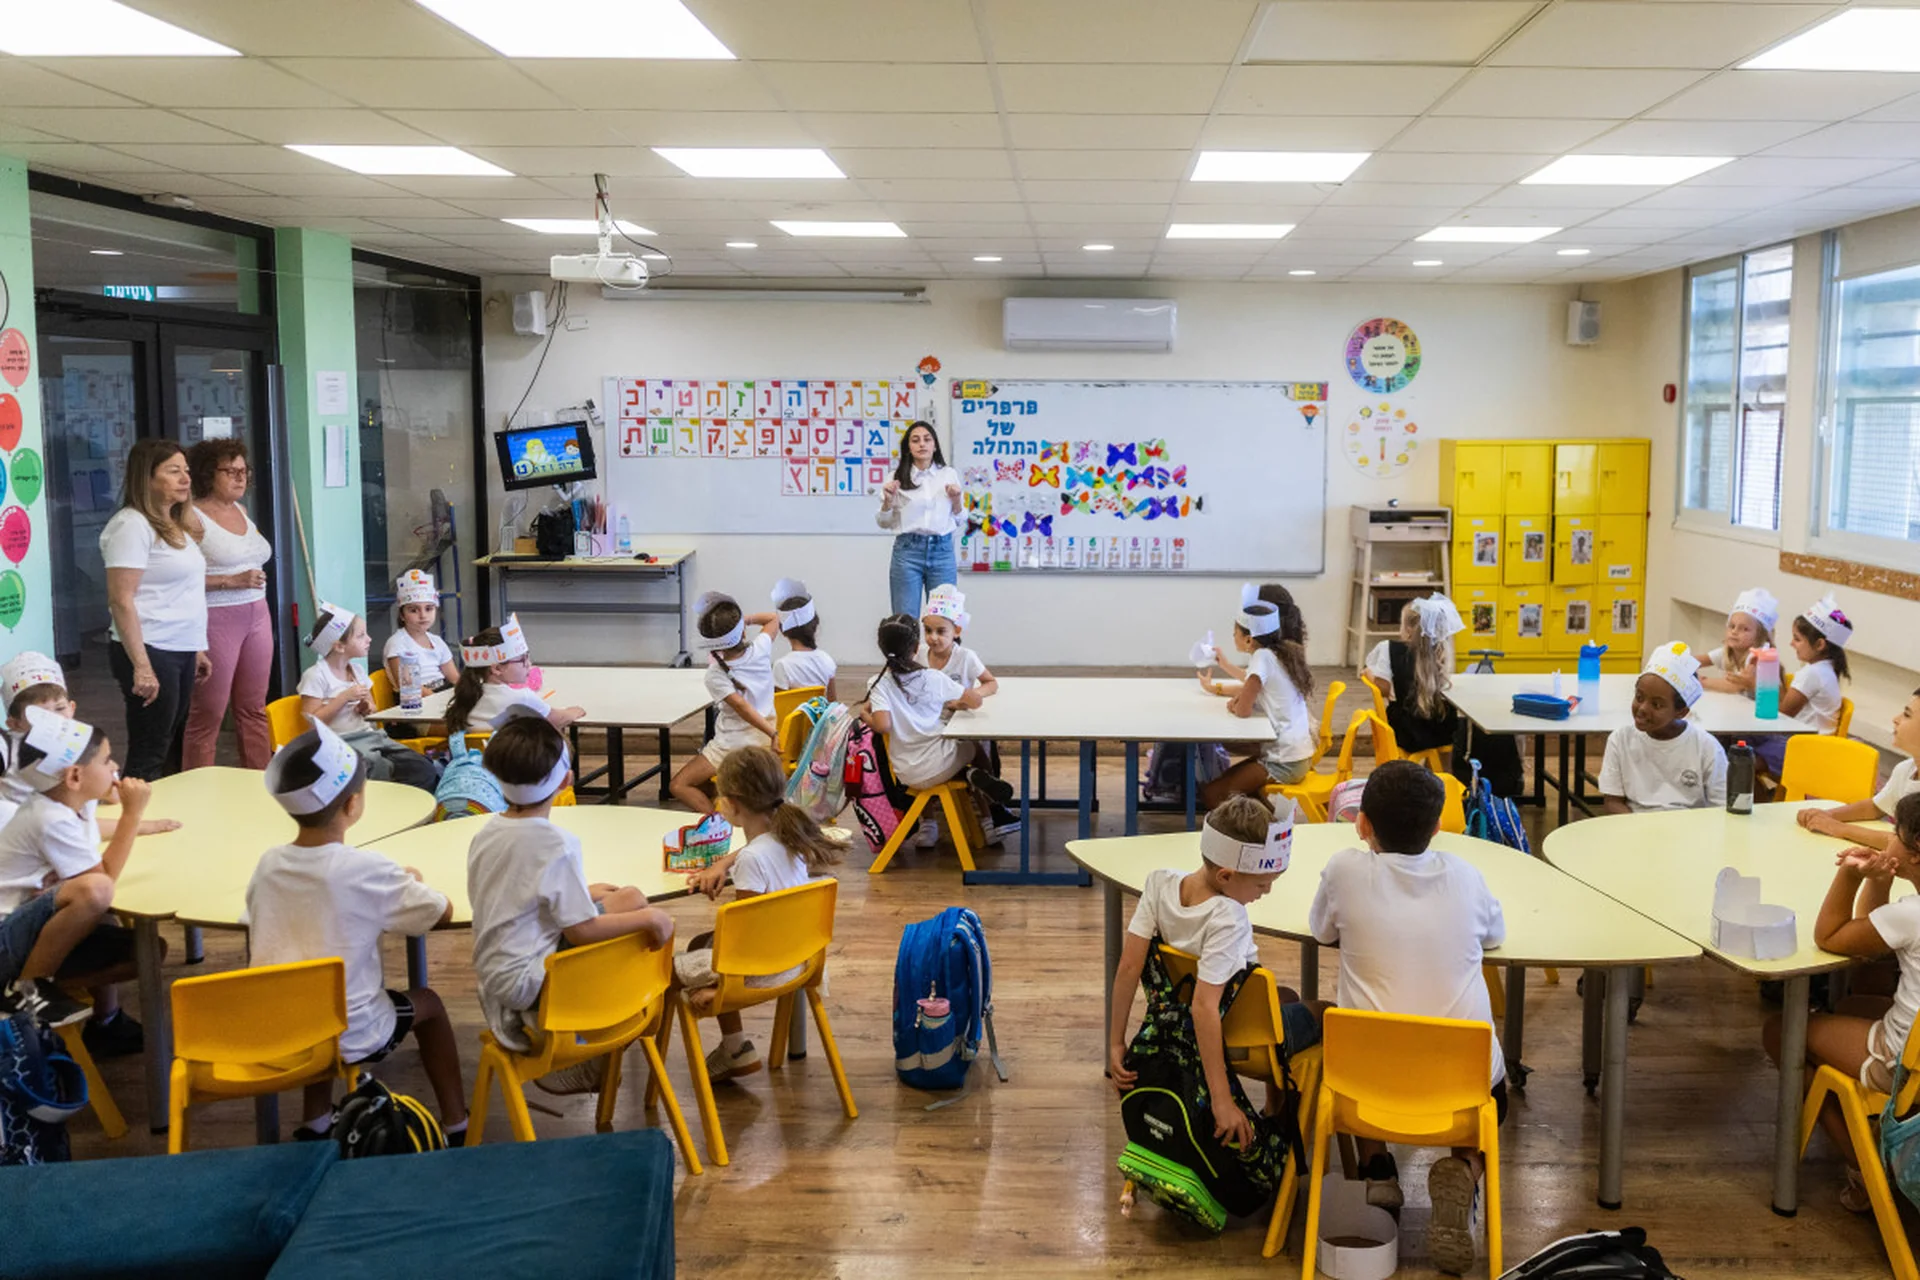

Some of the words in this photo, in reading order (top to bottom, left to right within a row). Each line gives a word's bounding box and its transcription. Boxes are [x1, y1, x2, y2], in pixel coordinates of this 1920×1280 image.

[626, 389, 639, 406] כ
[655, 389, 663, 400] י
[678, 390, 693, 406] ט
[707, 390, 721, 407] ח
[736, 390, 746, 407] ז
[764, 390, 771, 406] ו
[787, 390, 801, 406] ה
[814, 390, 828, 406] ד
[843, 390, 854, 406] ג
[868, 390, 884, 406] ב
[895, 391, 910, 408] א
[961, 400, 1038, 415] פרפרים
[624, 427, 642, 444] ת
[652, 427, 668, 444] ש
[680, 428, 693, 444] ר
[815, 428, 829, 444] ס
[987, 419, 1015, 436] של
[707, 428, 721, 454] ק
[733, 429, 748, 445] צ
[761, 428, 775, 445] פ
[788, 428, 802, 445] ע
[843, 429, 854, 445] נ
[868, 429, 885, 446] מ
[972, 437, 1037, 455] התחלה
[790, 467, 803, 492] ץ
[816, 467, 829, 492] ף
[845, 467, 852, 492] ן
[869, 467, 883, 484] ם
